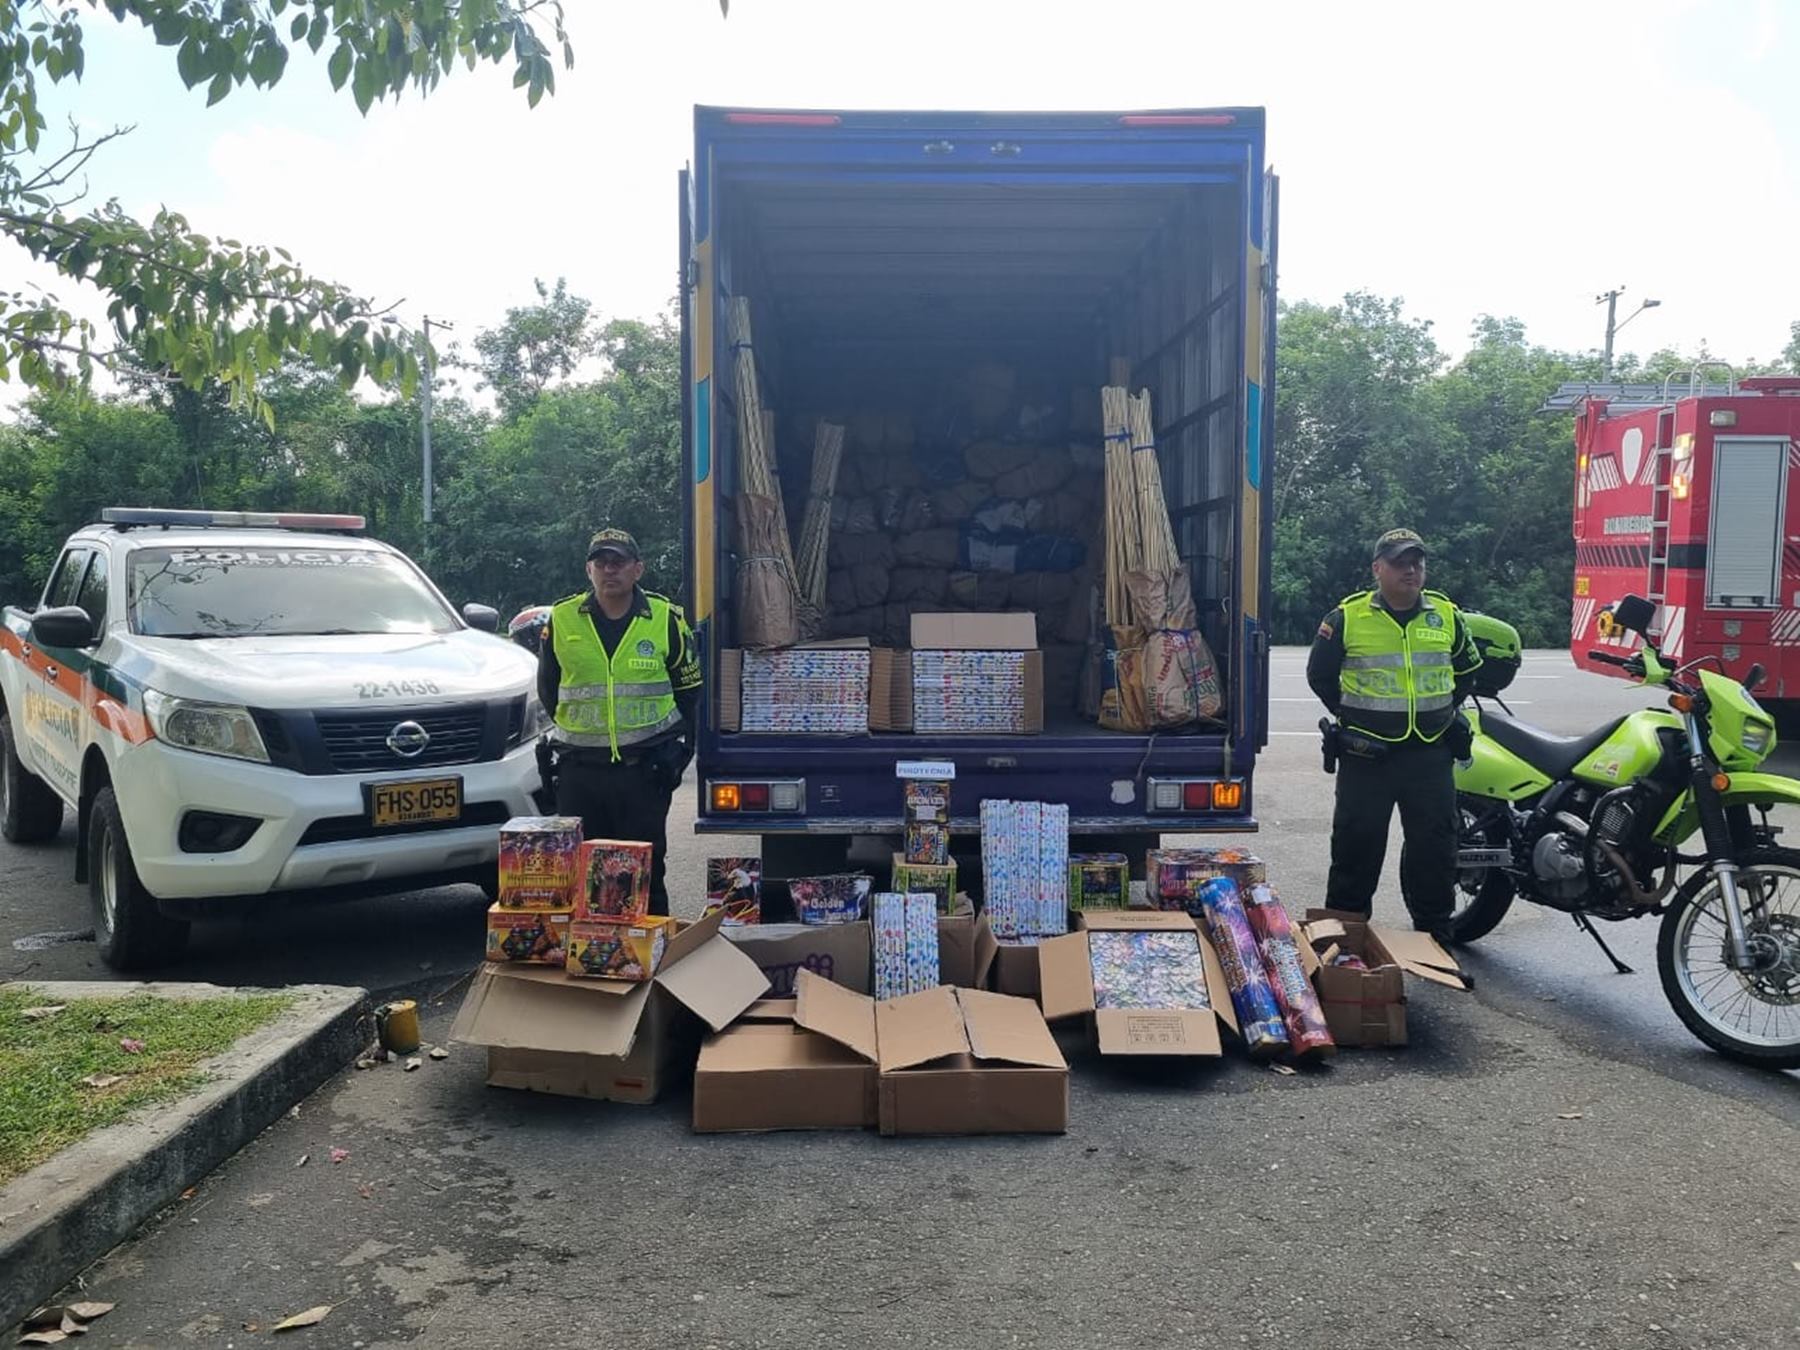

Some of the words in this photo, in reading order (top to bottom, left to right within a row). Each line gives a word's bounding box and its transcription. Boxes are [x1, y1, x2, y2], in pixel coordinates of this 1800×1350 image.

[1604, 515, 1653, 534] BOMBEROS
[169, 552, 376, 564] POLICIA
[899, 767, 953, 775] PIROTECNIA
[1460, 854, 1499, 862] SUZUKI
[811, 897, 845, 909] Golden
